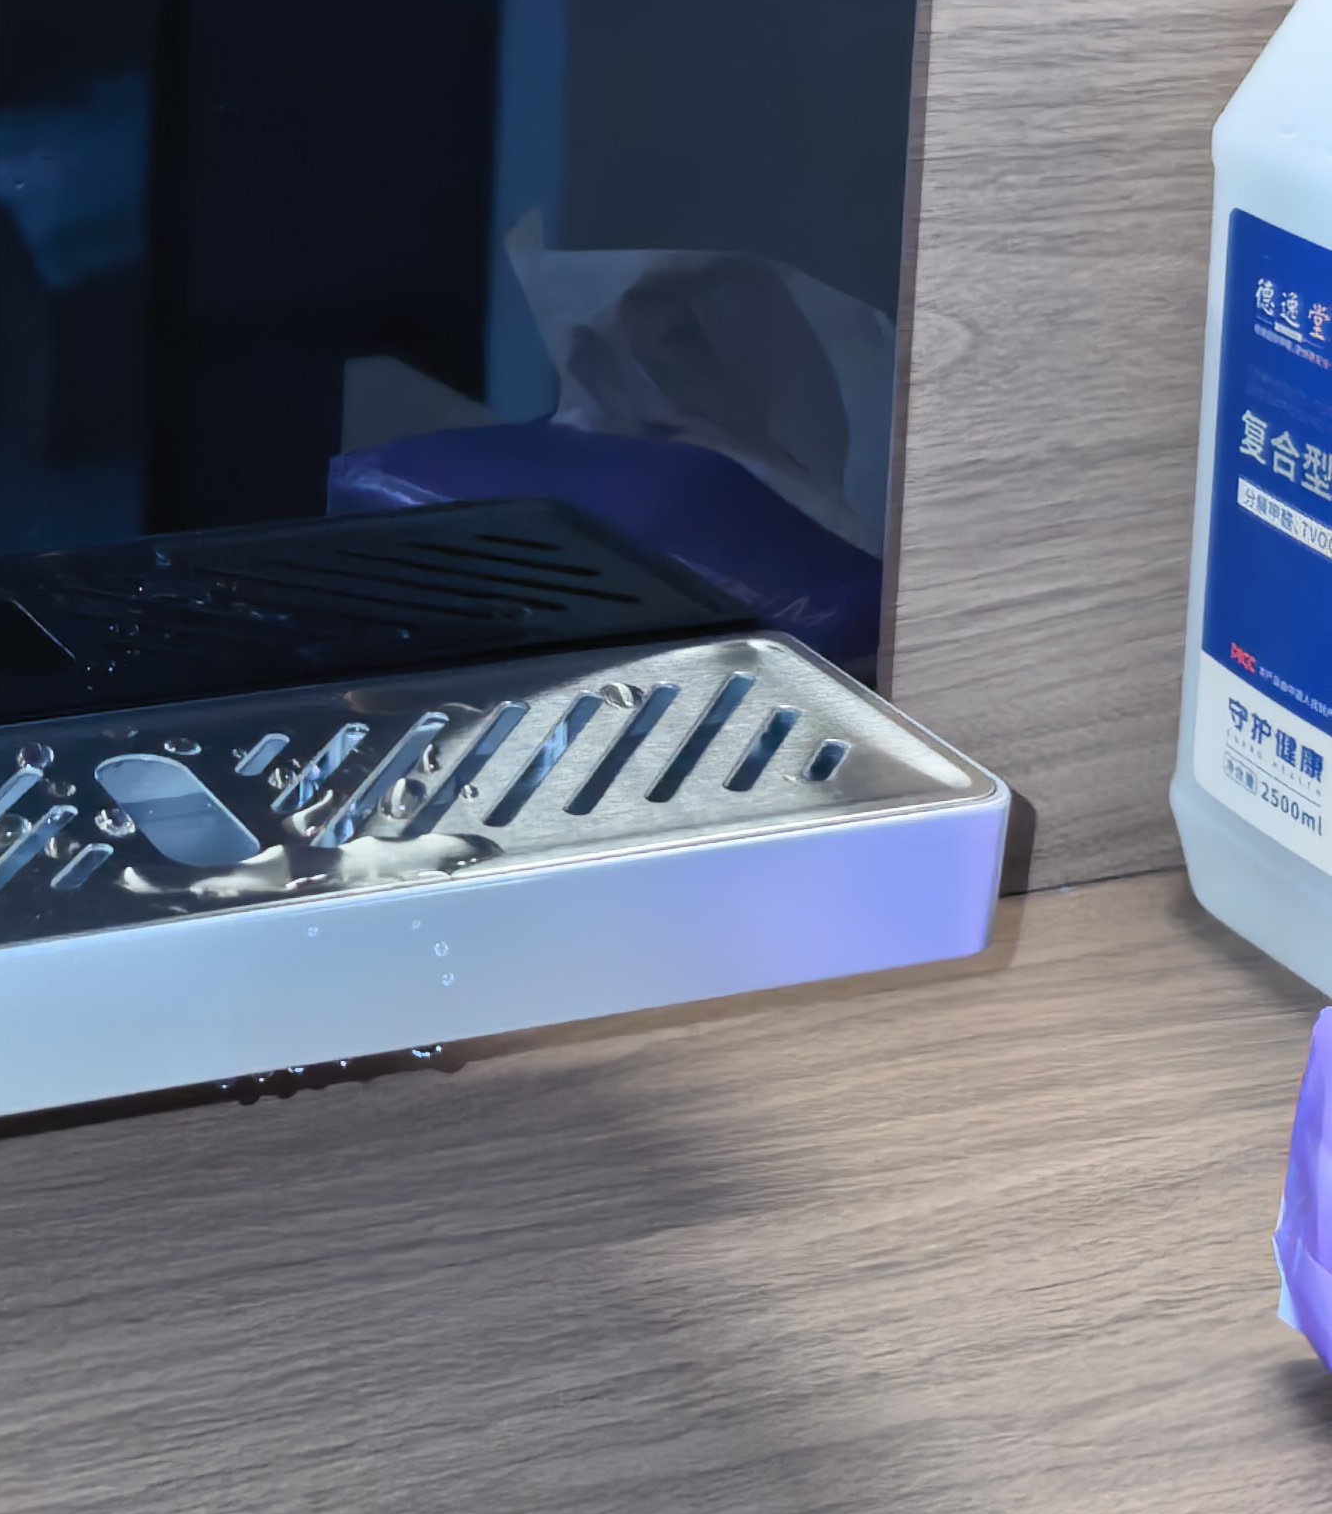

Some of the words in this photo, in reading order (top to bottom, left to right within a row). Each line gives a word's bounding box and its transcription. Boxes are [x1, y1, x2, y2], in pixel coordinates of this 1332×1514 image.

[1239, 409, 1332, 502] 复合型
[1228, 697, 1323, 783] 守护健康
[1260, 781, 1323, 837] 2500ml
